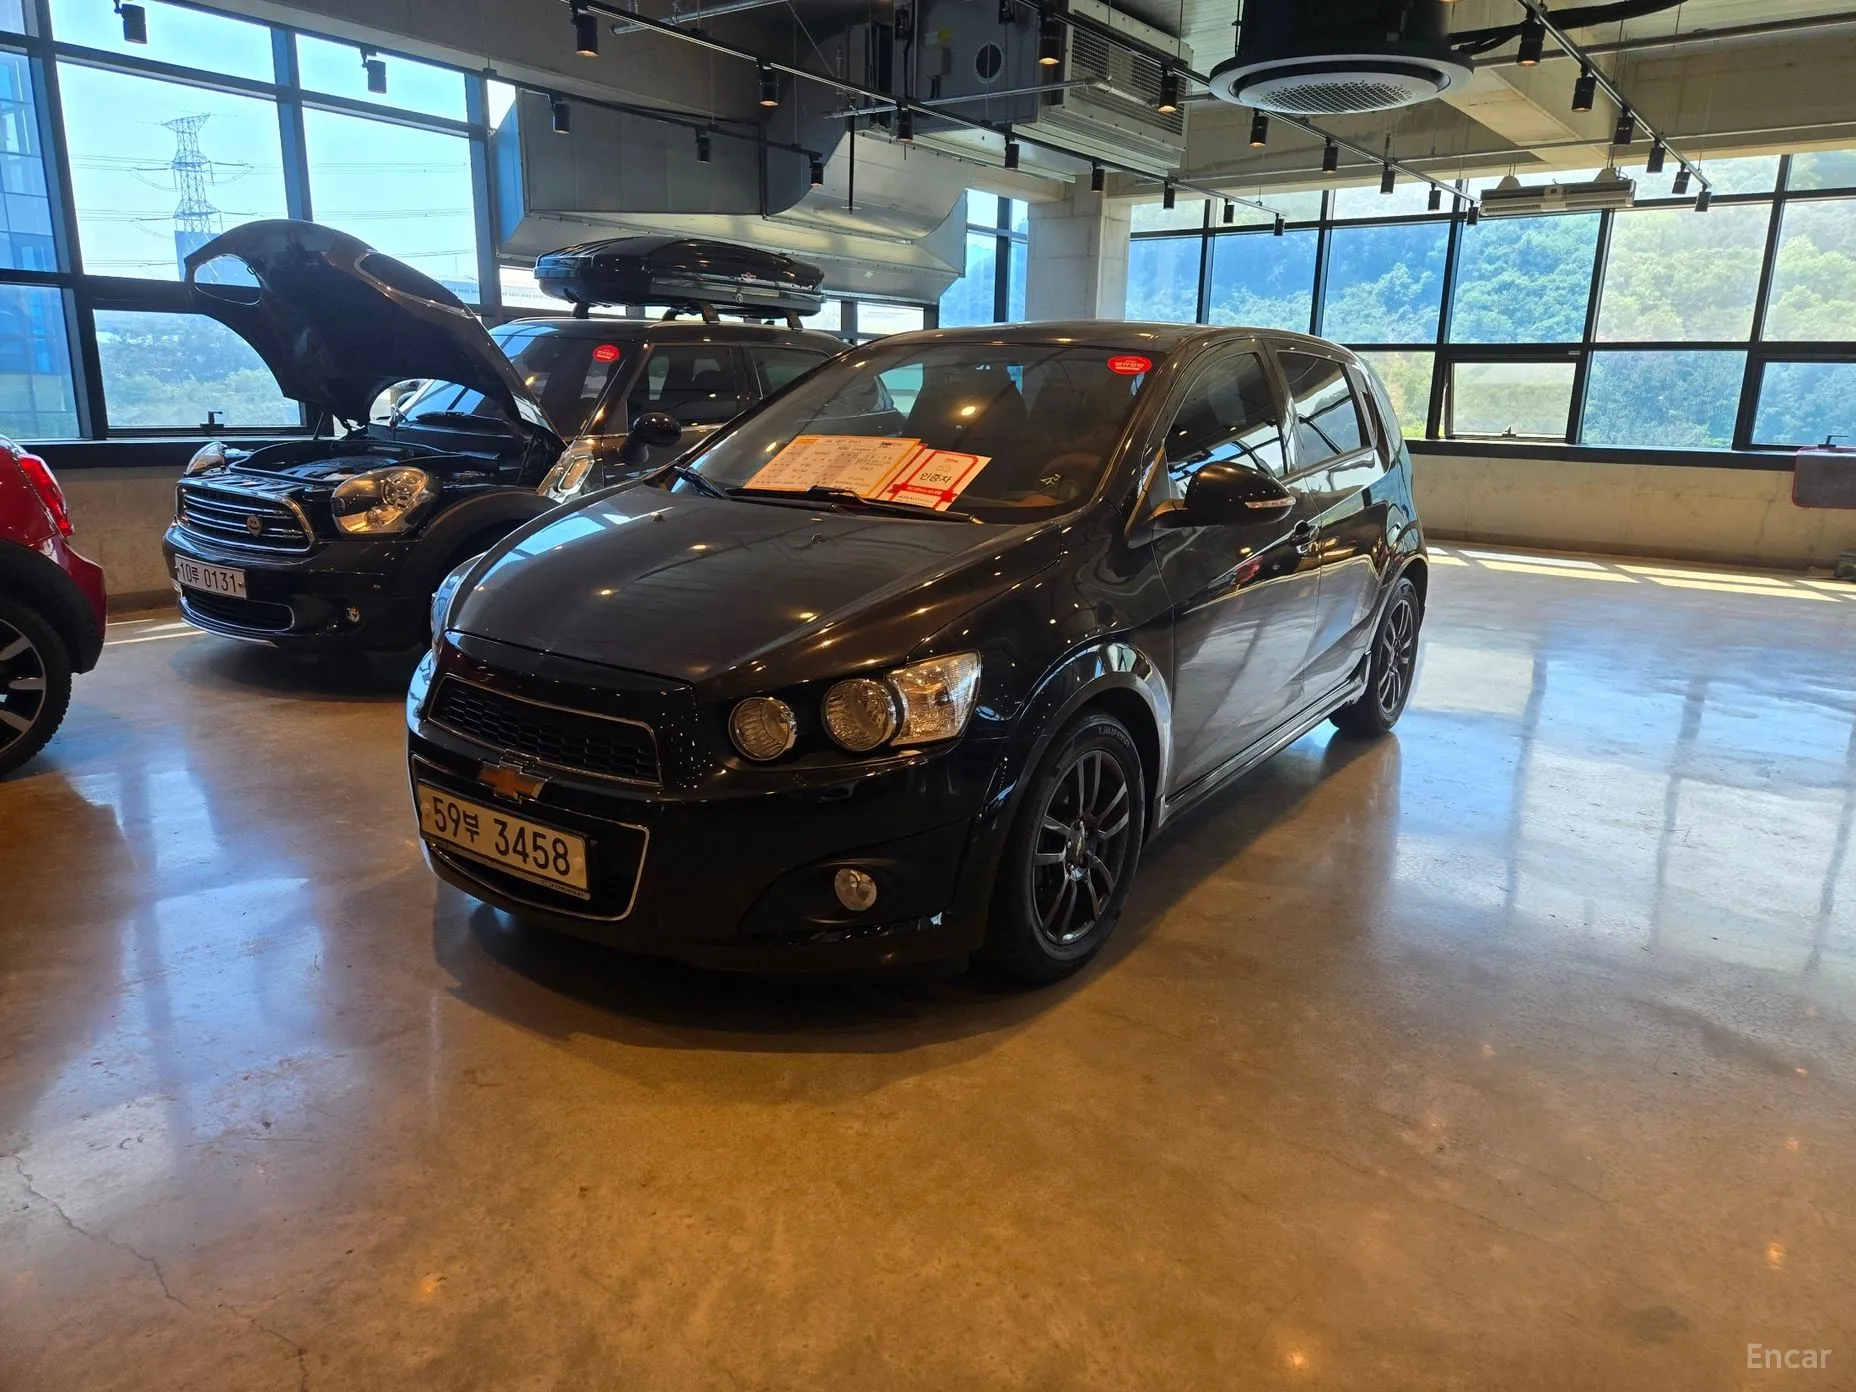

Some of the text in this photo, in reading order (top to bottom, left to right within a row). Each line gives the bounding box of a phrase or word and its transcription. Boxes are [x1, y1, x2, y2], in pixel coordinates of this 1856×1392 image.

[919, 472, 953, 485] 인증차
[180, 562, 237, 593] 10루 0131
[432, 796, 571, 877] 59부 3458
